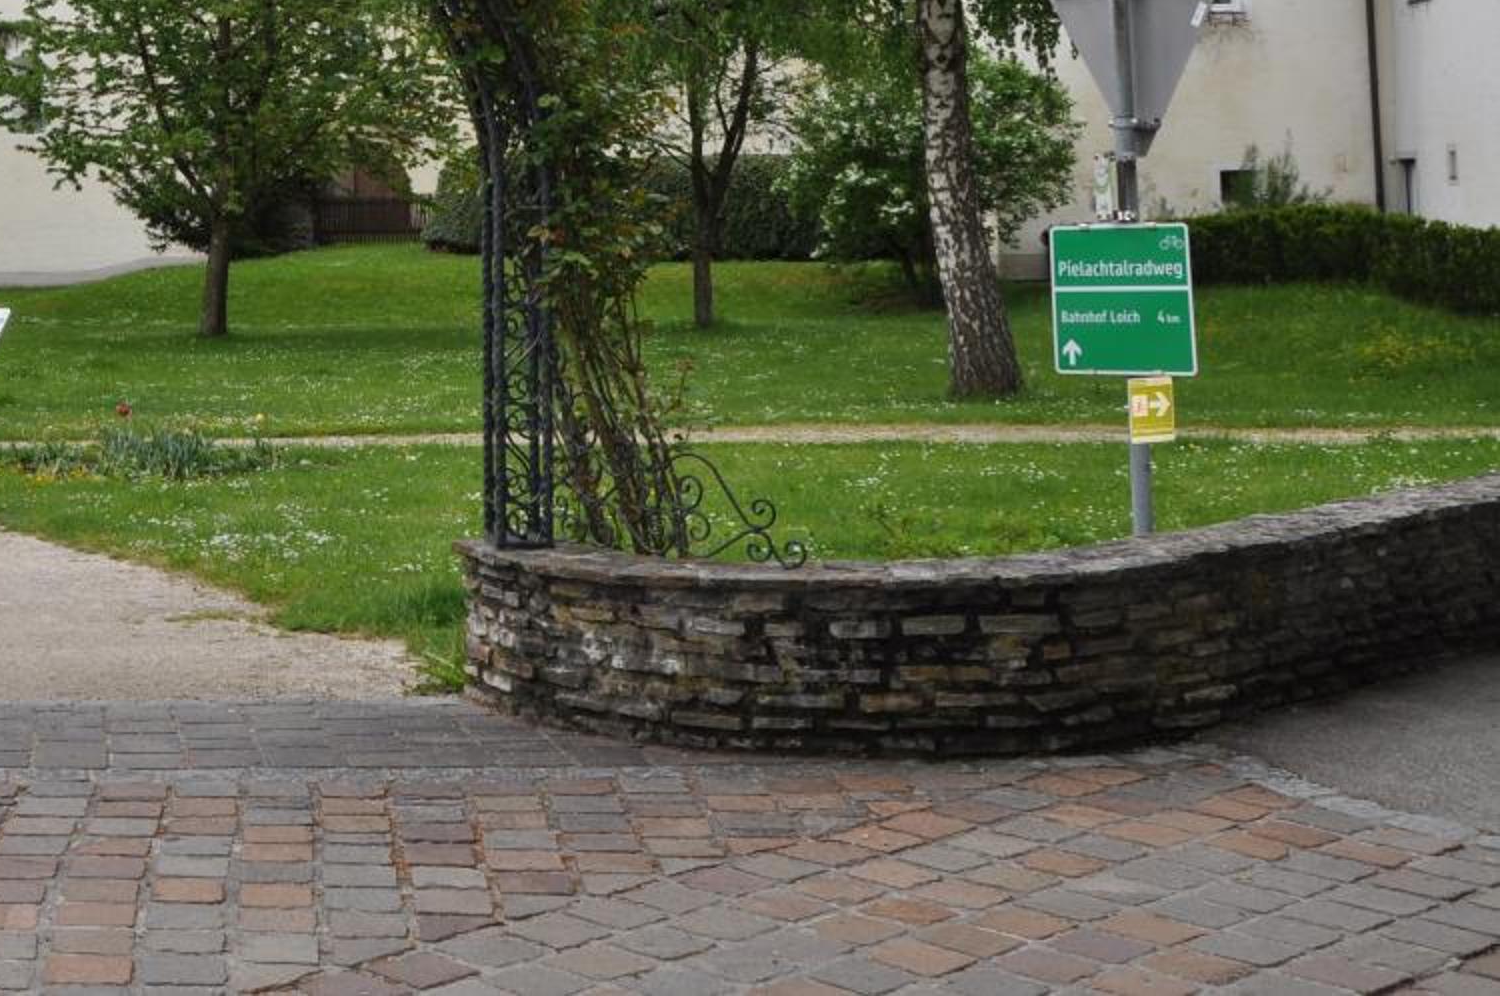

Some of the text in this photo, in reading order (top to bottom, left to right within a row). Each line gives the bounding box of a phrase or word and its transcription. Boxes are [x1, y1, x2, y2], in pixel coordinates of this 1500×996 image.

[1058, 260, 1183, 279] Pielachtalradweg
[1061, 310, 1180, 324] Bahnhof Loich 4 km
